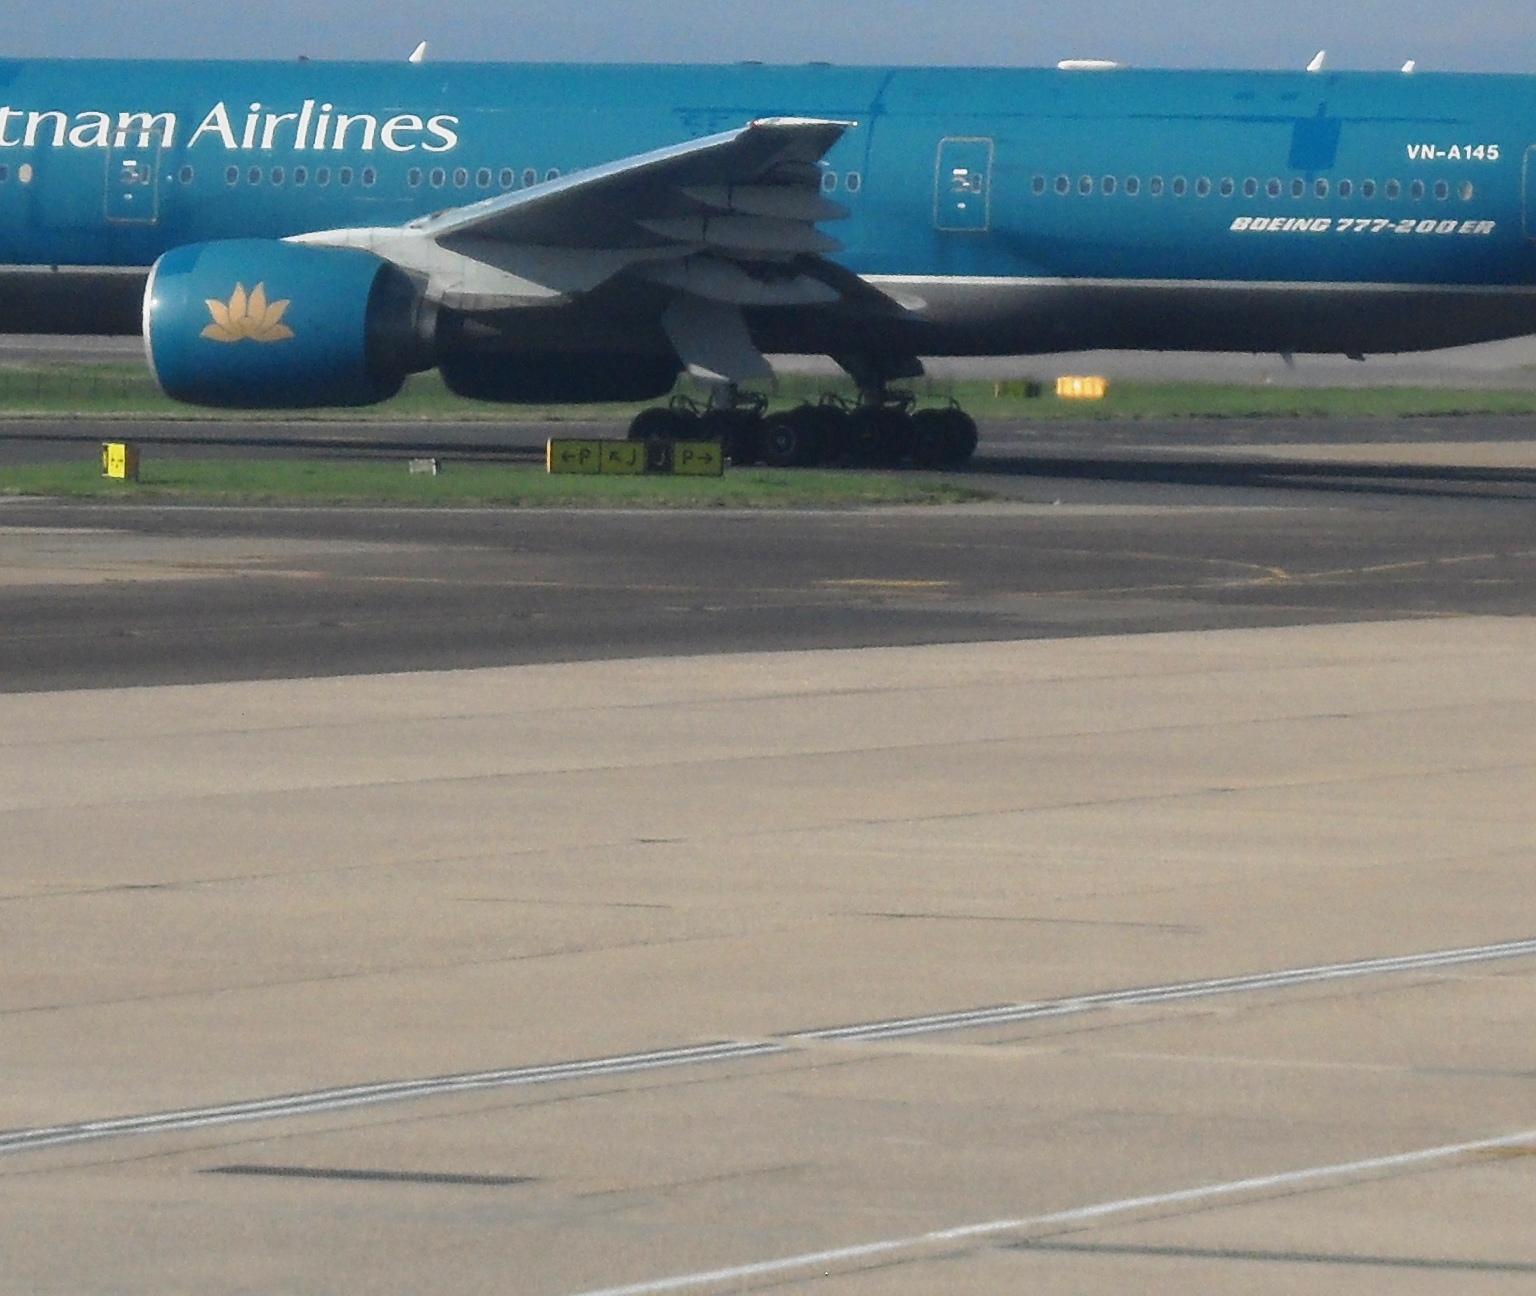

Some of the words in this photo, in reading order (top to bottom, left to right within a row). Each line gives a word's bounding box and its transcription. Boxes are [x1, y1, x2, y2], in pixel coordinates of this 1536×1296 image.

[187, 100, 460, 153] Airlines
[1406, 144, 1499, 160] VN-A145
[1230, 216, 1333, 232] BOEING
[579, 448, 591, 465] P
[627, 448, 637, 466] J
[683, 449, 695, 465] P
